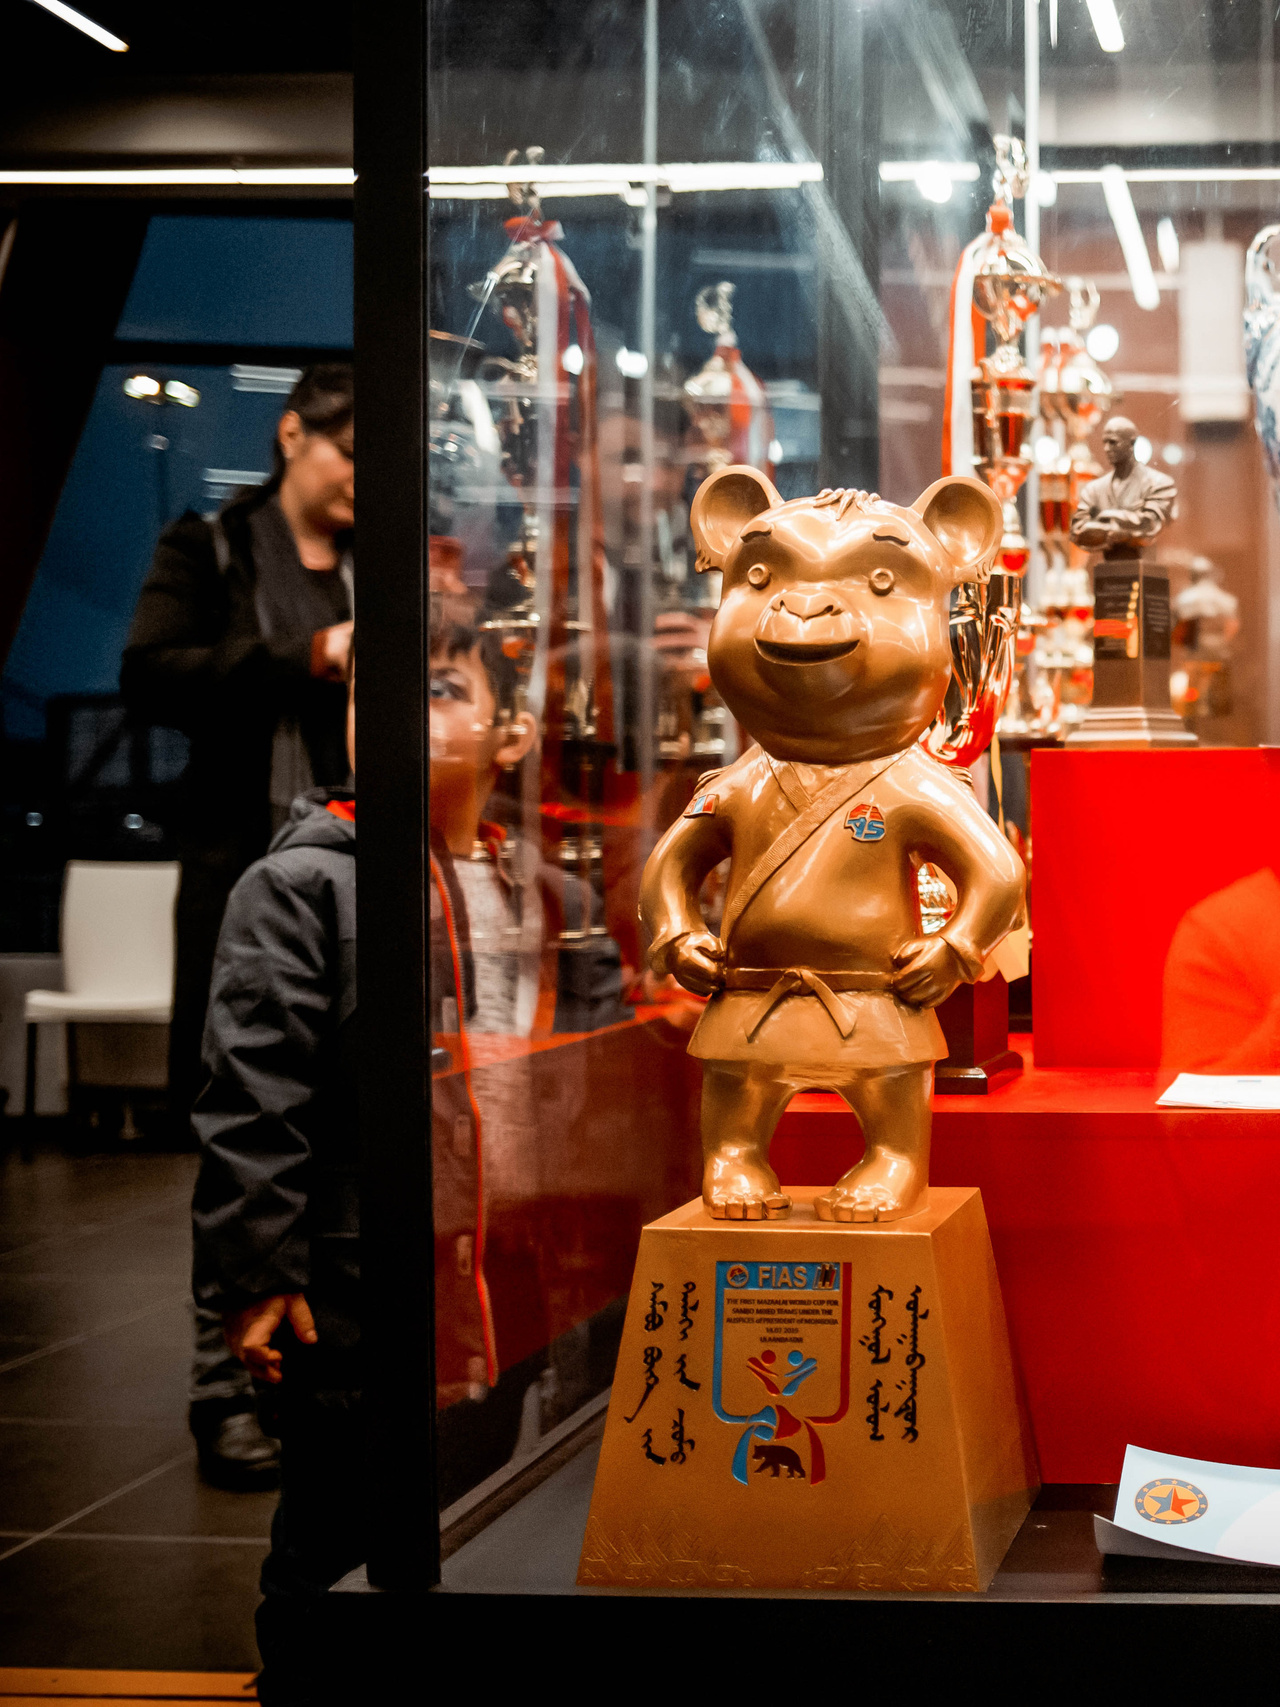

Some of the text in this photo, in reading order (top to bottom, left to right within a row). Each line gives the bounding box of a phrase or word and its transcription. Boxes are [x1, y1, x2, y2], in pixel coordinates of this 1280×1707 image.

[758, 1265, 808, 1288] FIAS
[827, 1299, 839, 1307] FOR
[732, 1307, 755, 1315] SAMBO
[799, 1308, 821, 1316] UNDER
